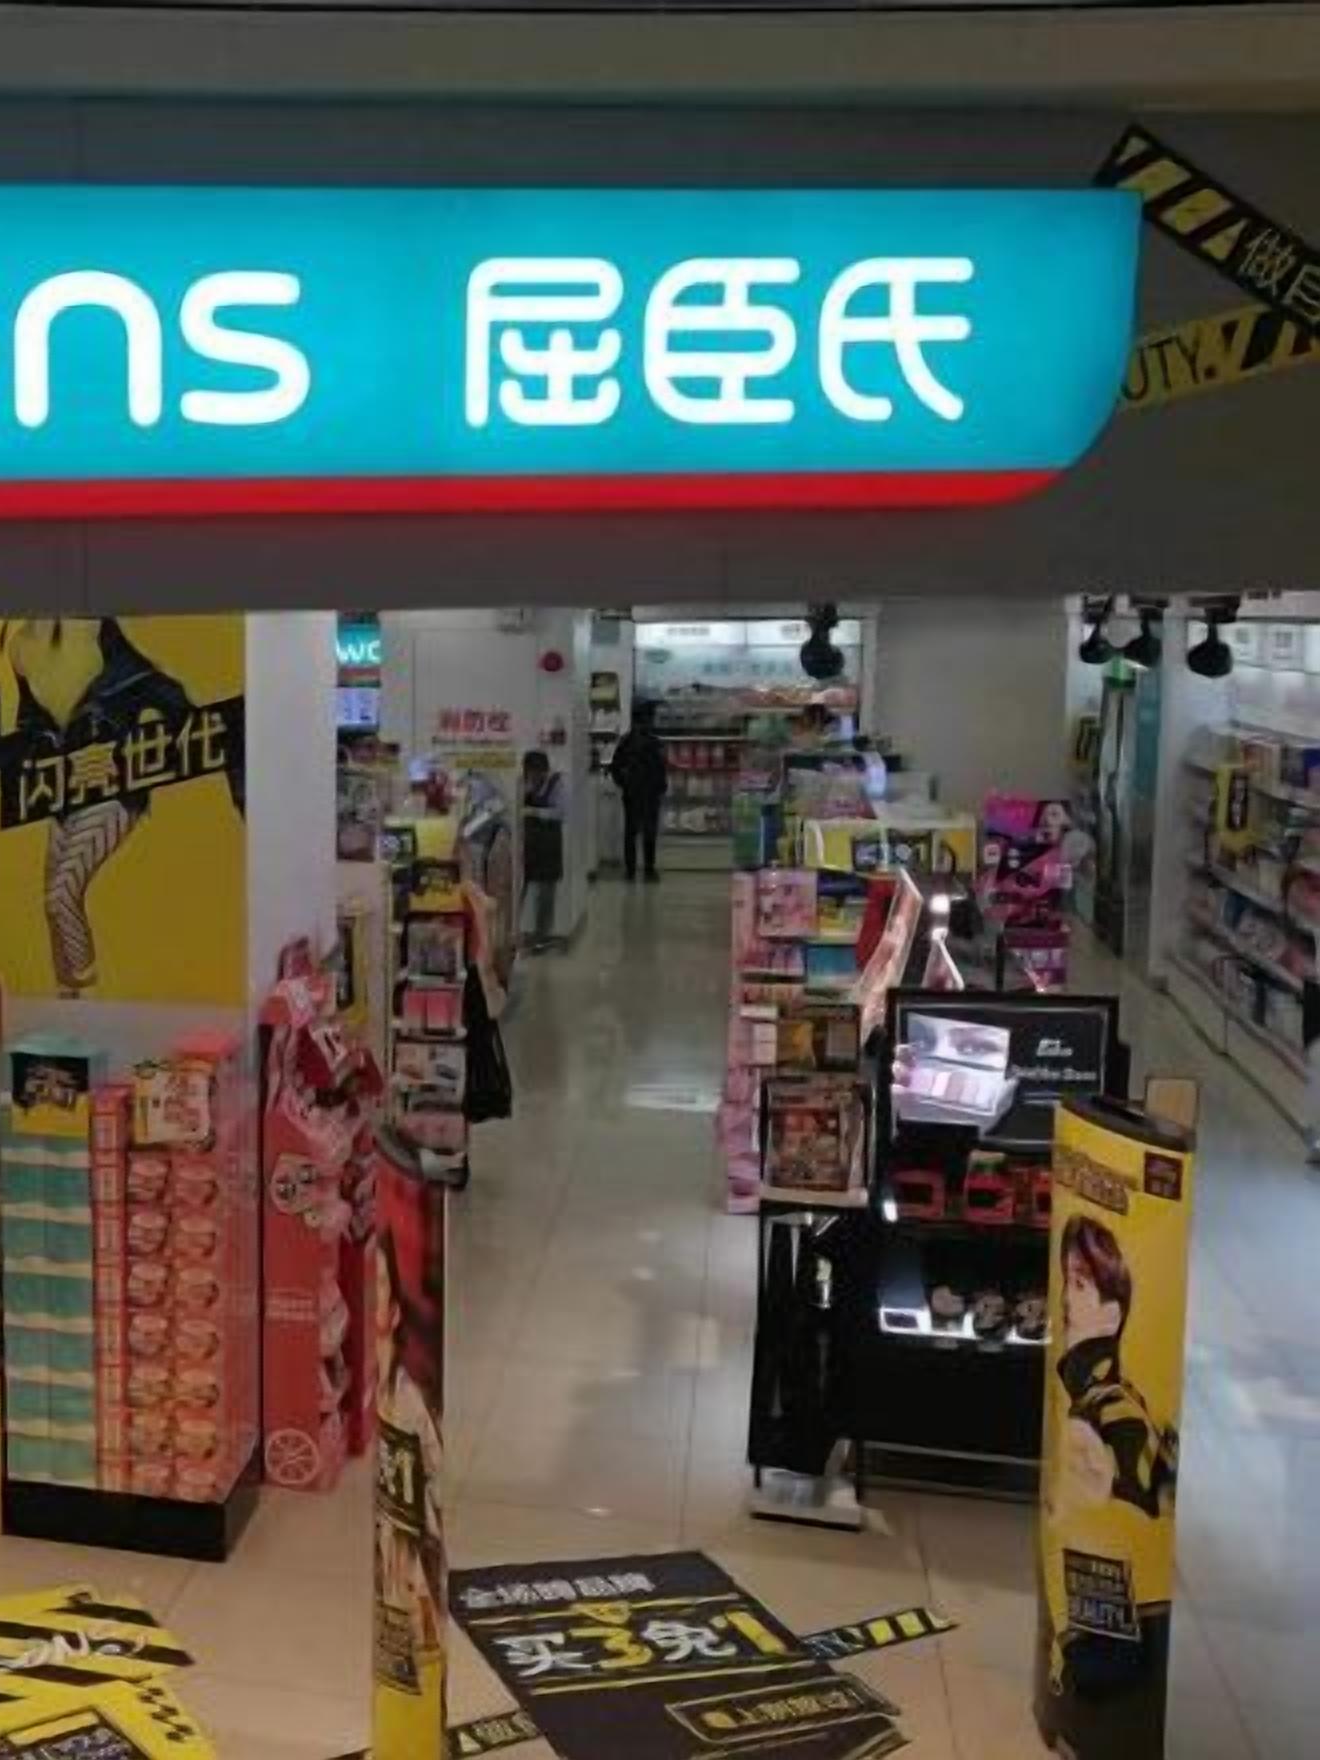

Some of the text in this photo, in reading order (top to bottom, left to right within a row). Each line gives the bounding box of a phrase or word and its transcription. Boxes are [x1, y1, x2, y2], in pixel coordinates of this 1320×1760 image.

[465, 256, 975, 428] 屈臣氏
[19, 714, 229, 820] 闪亮世代
[490, 1608, 790, 1678] 买3免1
